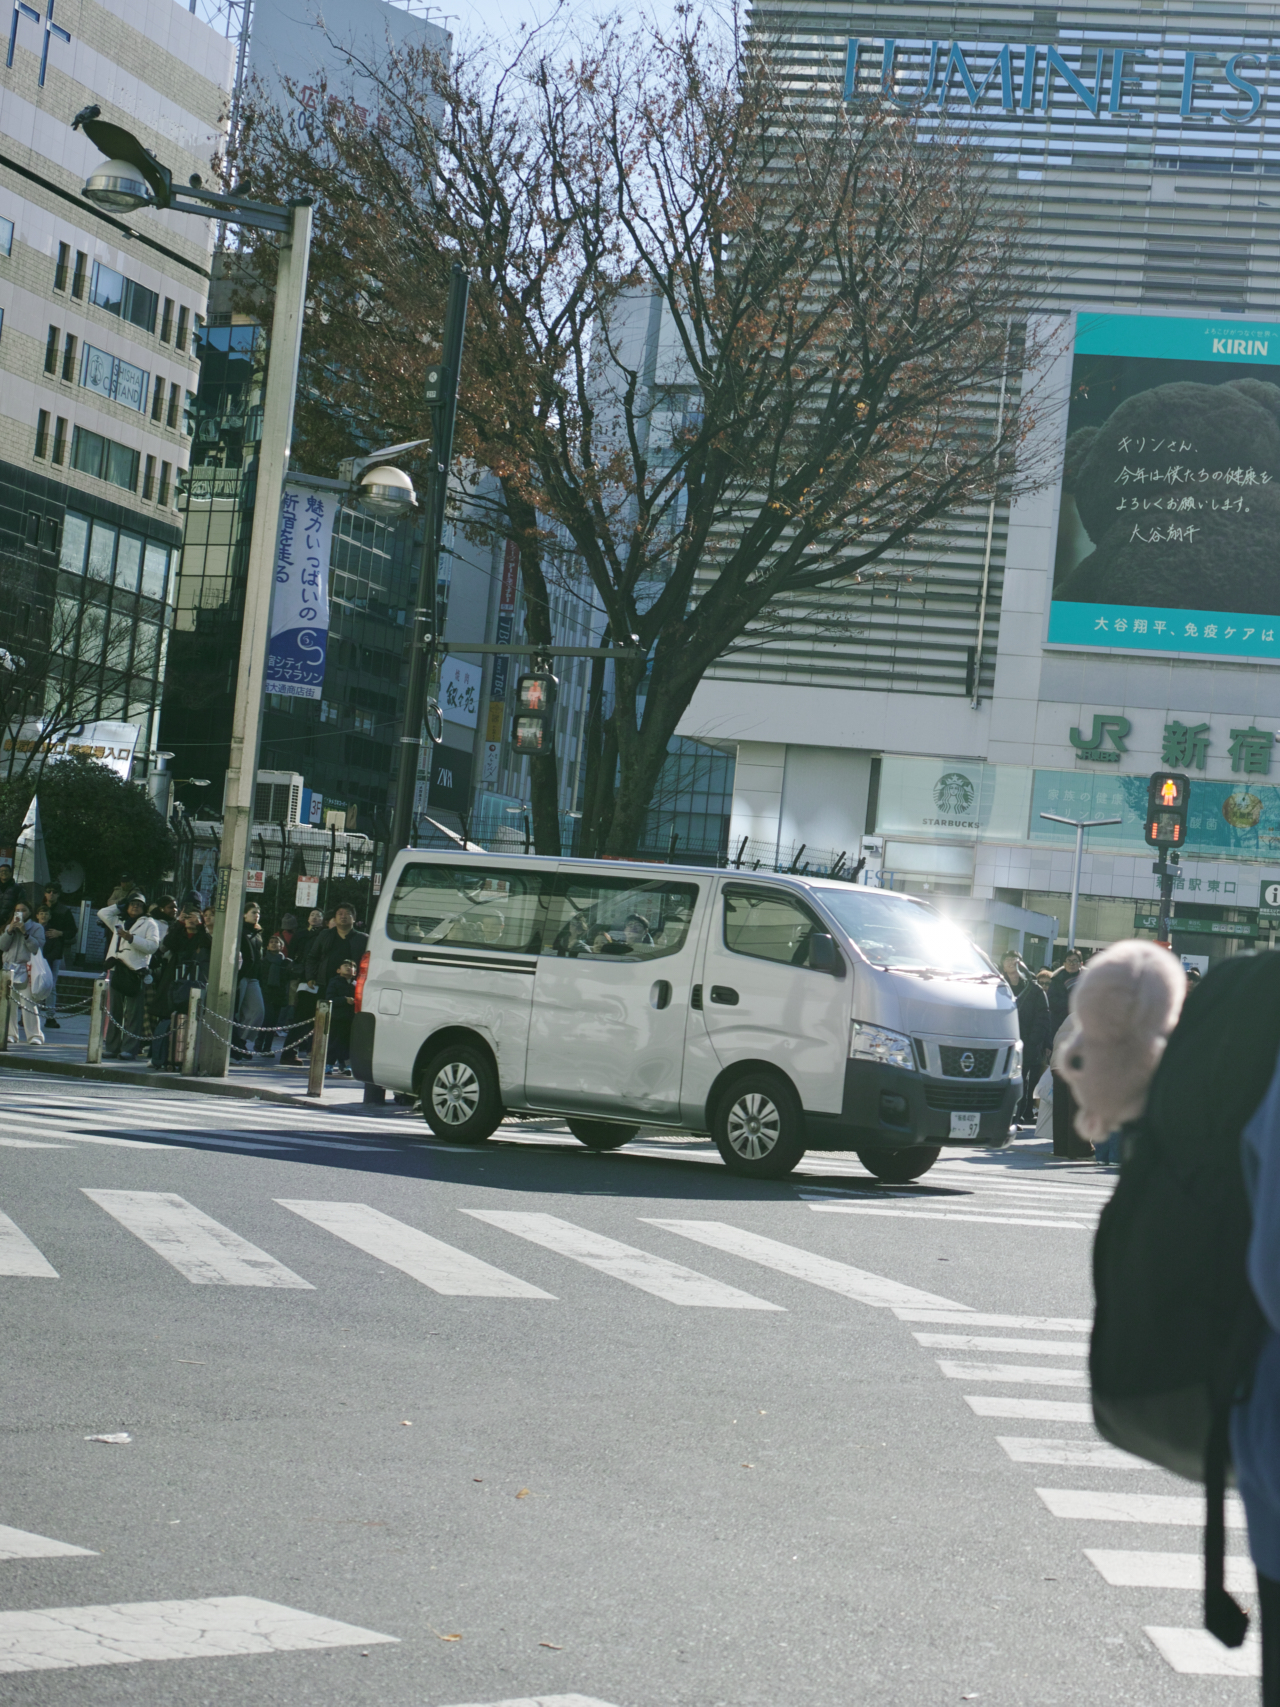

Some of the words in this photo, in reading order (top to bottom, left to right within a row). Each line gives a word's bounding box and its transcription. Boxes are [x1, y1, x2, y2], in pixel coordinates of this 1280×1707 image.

[843, 38, 1146, 118] LUMINE
[1203, 328, 1279, 339] よろこびがつなぐ世界へ
[1212, 338, 1269, 357] KIRIN
[1117, 436, 1199, 455] キリンさん、
[1114, 465, 1273, 485] 今年は僕たちの健康を
[1115, 495, 1251, 514] よろしくお願いします。
[1129, 523, 1200, 544] 大谷翔平
[299, 495, 324, 621] 魅力いっぱいの
[1069, 714, 1131, 752] JR
[311, 800, 321, 815] 3F
[922, 818, 980, 829] STARBUCKS
[1143, 917, 1156, 925] JR
[968, 1123, 978, 1136] 97
